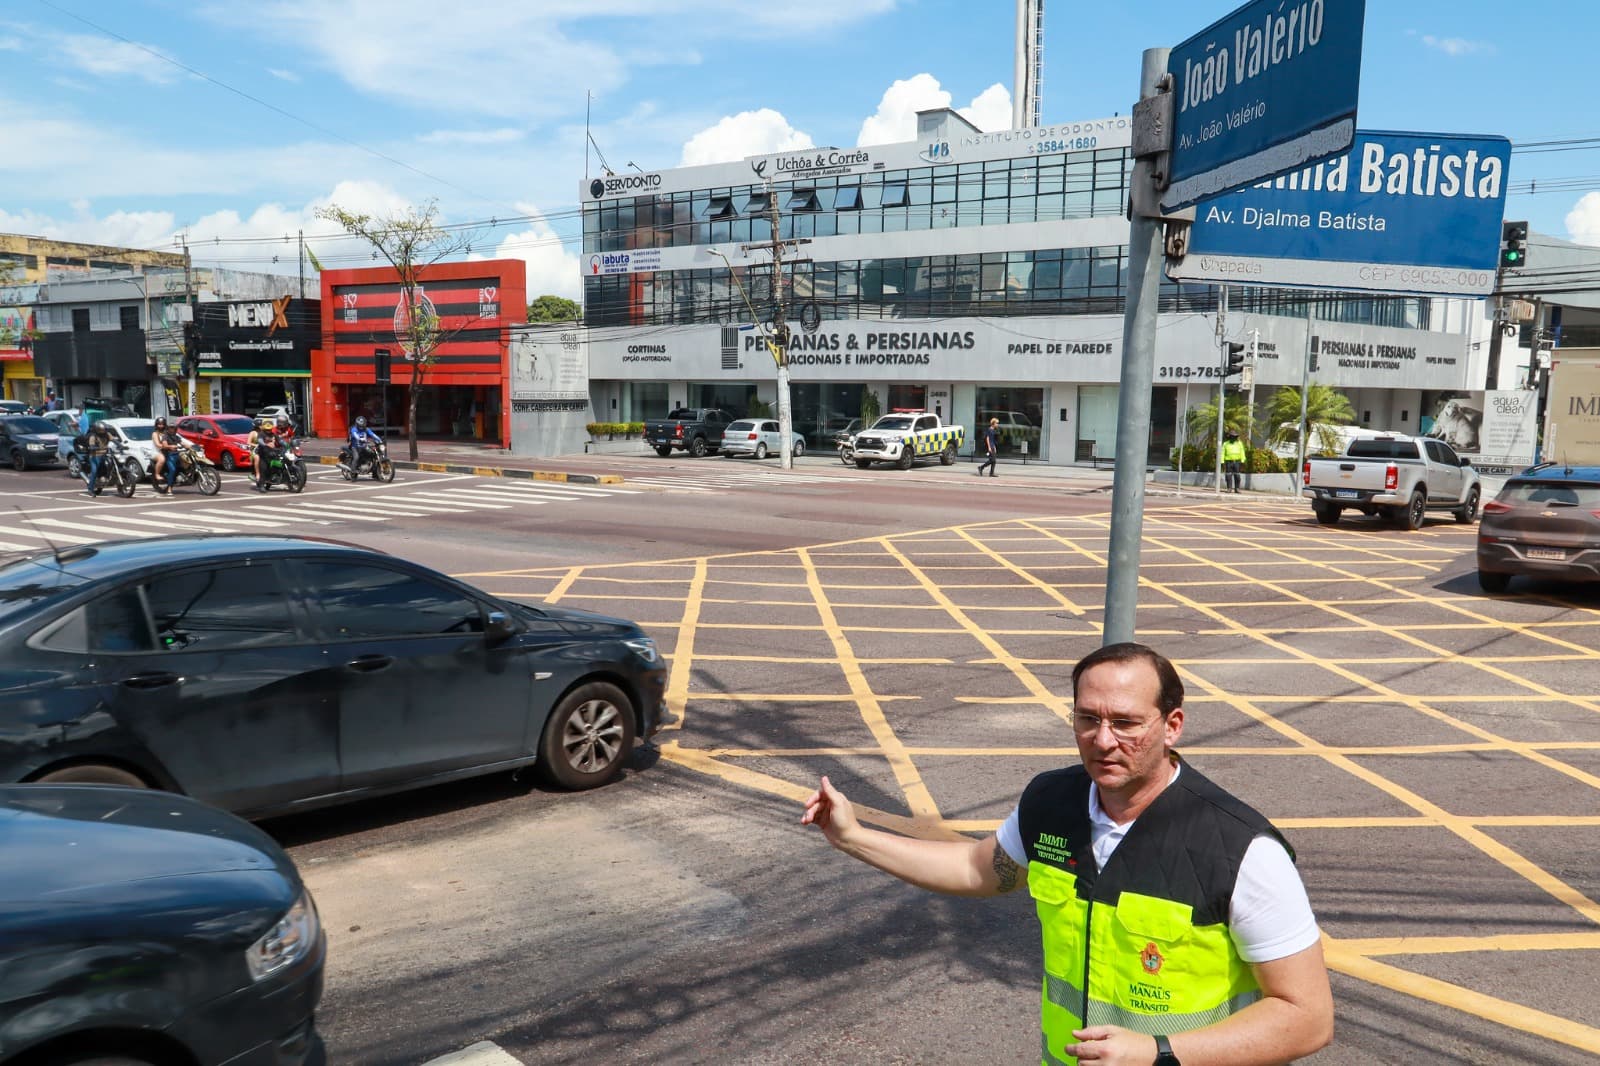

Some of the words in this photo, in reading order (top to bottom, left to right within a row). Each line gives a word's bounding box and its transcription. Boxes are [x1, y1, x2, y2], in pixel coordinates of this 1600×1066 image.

[1181, 42, 1228, 112] João
[1235, 0, 1323, 84] Valério
[1179, 133, 1194, 149] Av.
[1197, 119, 1223, 144] João
[1226, 99, 1265, 131] Valério
[960, 130, 1032, 147] INSTITUTO
[1039, 127, 1055, 137] DE
[1037, 136, 1097, 153] 3584-1680
[815, 154, 825, 168] &
[828, 150, 869, 166] Corrêa
[1360, 142, 1502, 199] Batista
[1206, 206, 1235, 223] Av.
[1243, 207, 1311, 230] Djalma
[1318, 211, 1386, 231] Batista
[1360, 266, 1395, 281] CEP
[628, 344, 666, 354] CORTINAS
[846, 332, 860, 350] &
[866, 331, 975, 350] PERSIANAS
[1007, 343, 1043, 354] PAPEL
[1046, 343, 1062, 354] DE
[1065, 343, 1113, 354] PAREDE
[1321, 340, 1366, 357] PERSIANAS
[1367, 344, 1374, 357] &
[1376, 344, 1417, 360] PERSIANAS
[845, 354, 851, 365] E
[855, 353, 930, 365] IMPORTADAS
[1493, 396, 1519, 407] aqua
[1496, 403, 1525, 414] clean
[1039, 832, 1068, 849] IMMU
[1130, 984, 1171, 1000] MANAUS
